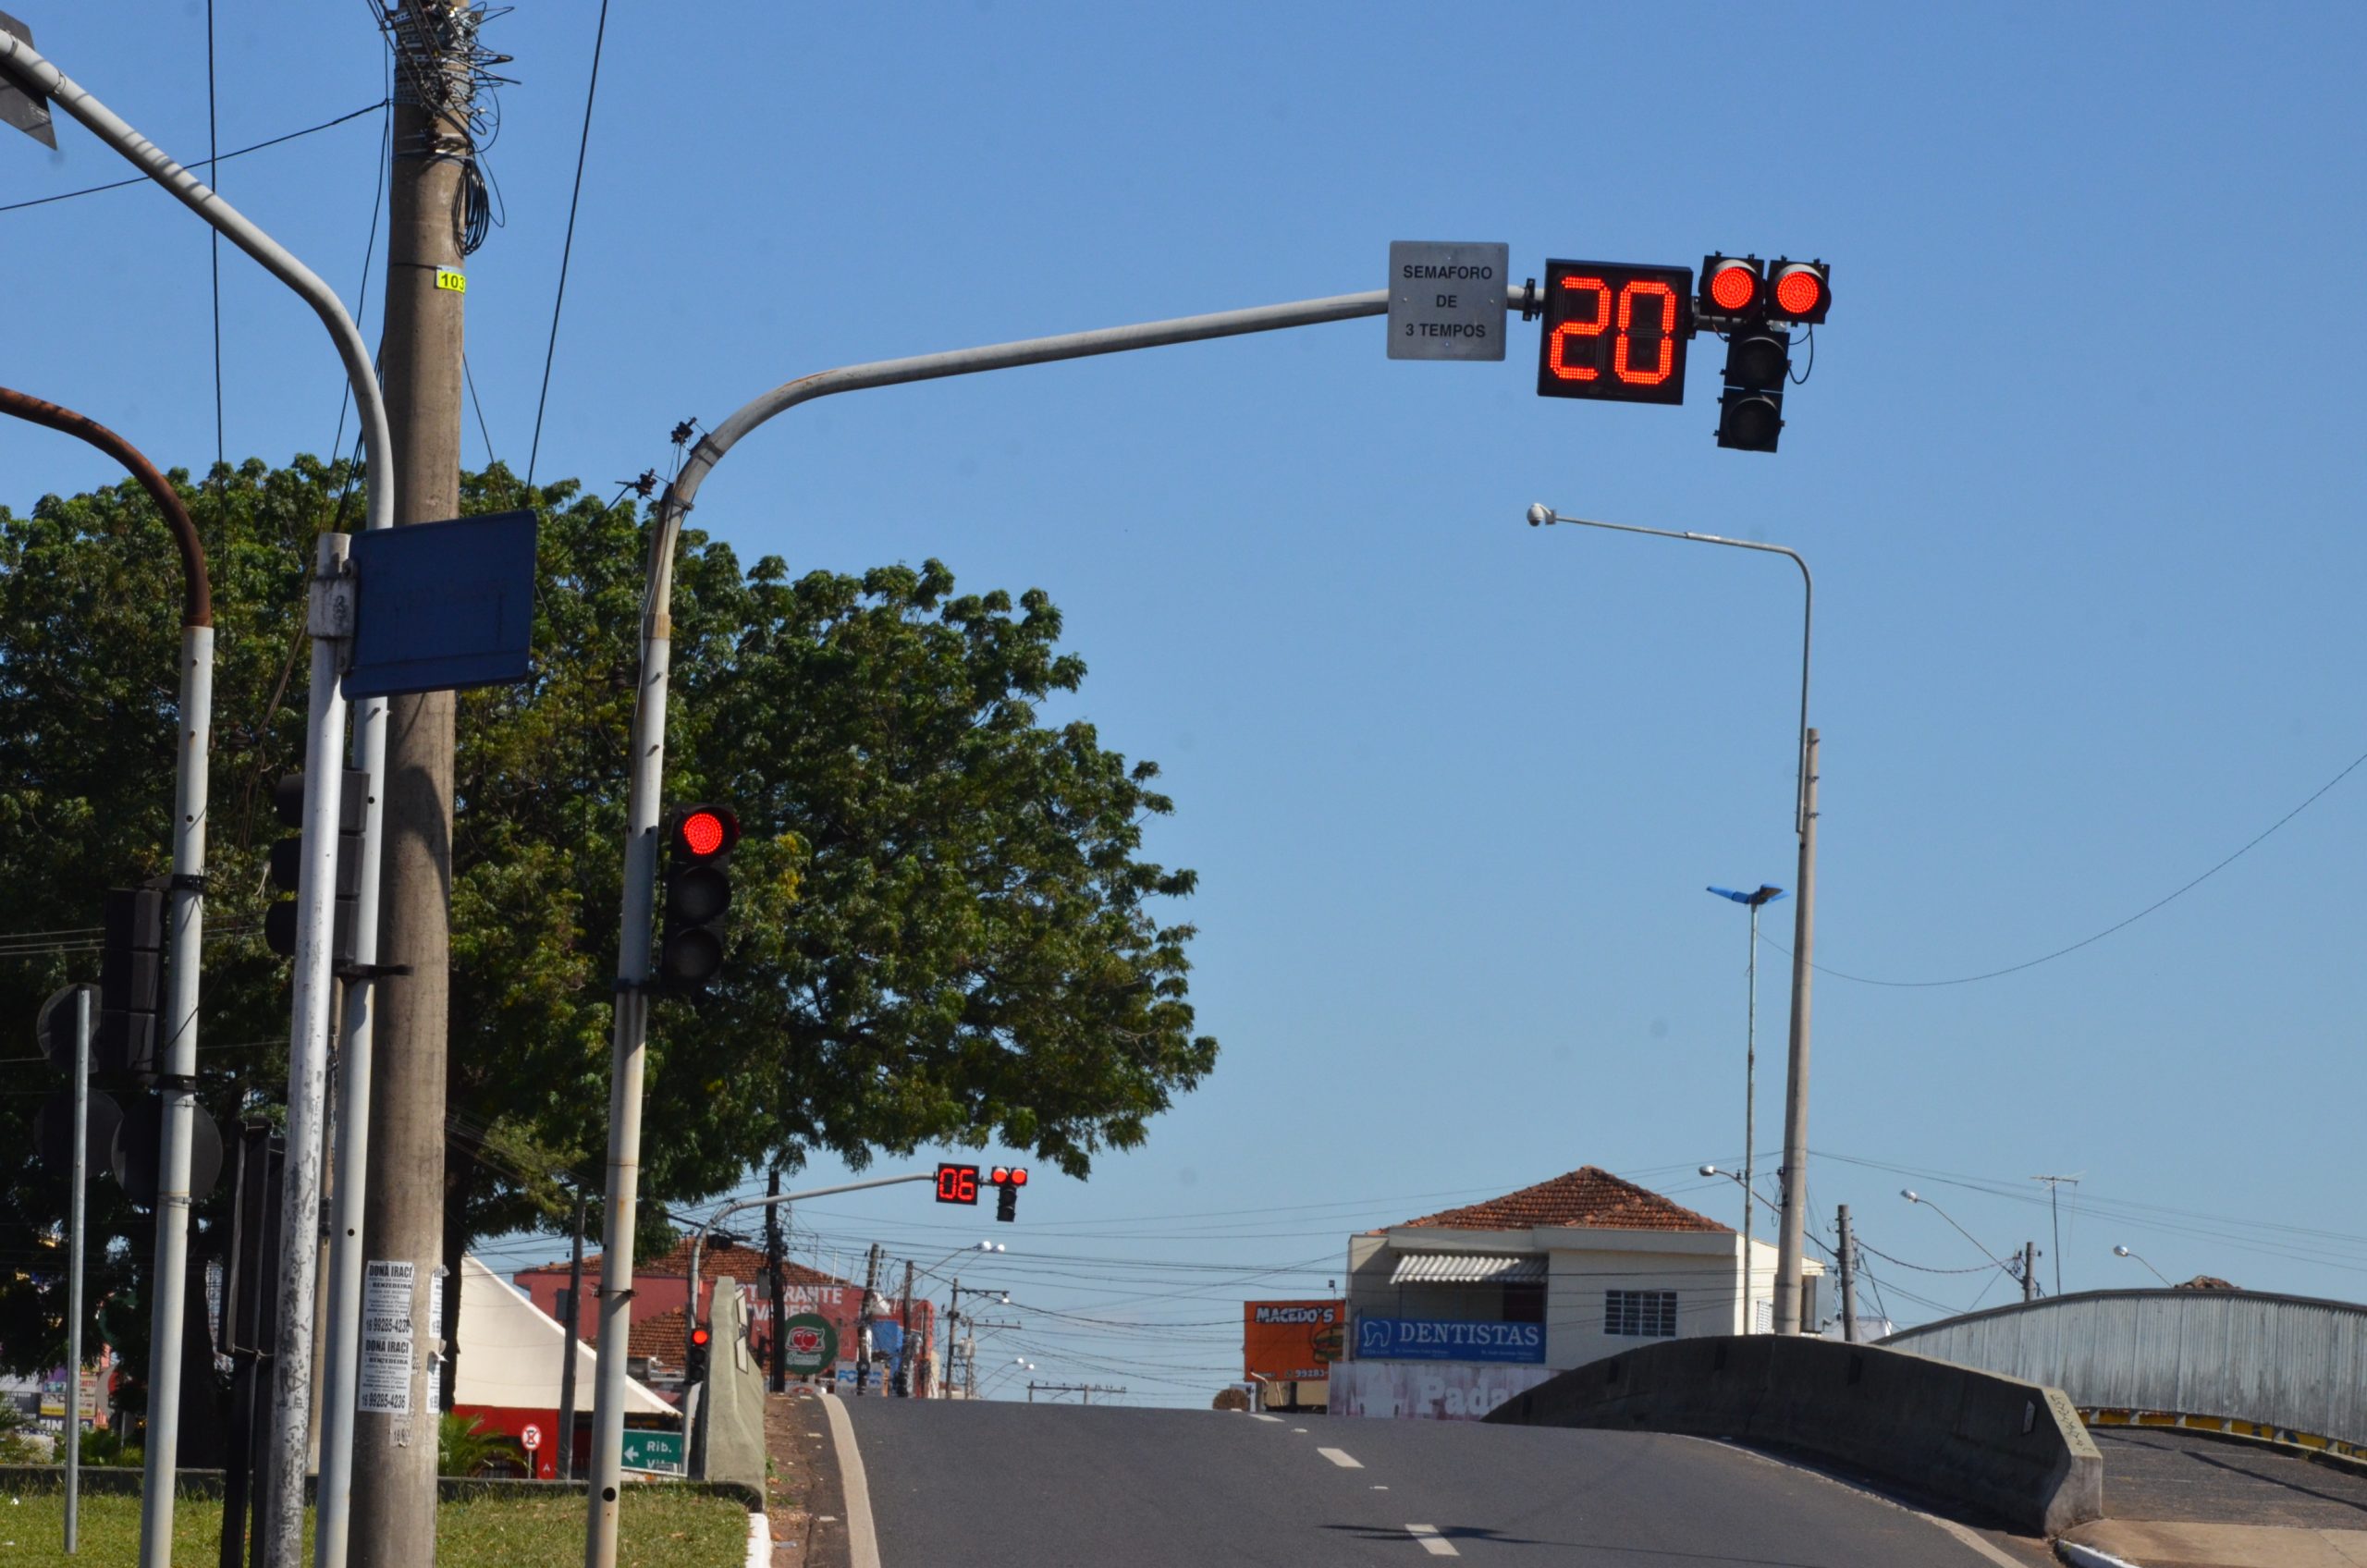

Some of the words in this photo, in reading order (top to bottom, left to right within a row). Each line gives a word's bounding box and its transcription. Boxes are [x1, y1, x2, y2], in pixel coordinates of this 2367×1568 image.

[1403, 264, 1493, 280] SEMAFORO
[441, 273, 465, 291] 103
[1435, 294, 1458, 309] DE
[1405, 324, 1415, 337] 3
[1419, 324, 1487, 338] TEMPOS
[1550, 276, 1676, 385] 20
[938, 1168, 975, 1201] 06
[369, 1265, 389, 1277] DONA
[1256, 1306, 1334, 1324] MACEDO'S
[1398, 1322, 1539, 1346] DENTISTAS
[365, 1340, 386, 1352] DONA
[387, 1341, 410, 1354] IRACI
[646, 1440, 672, 1453] Rib.
